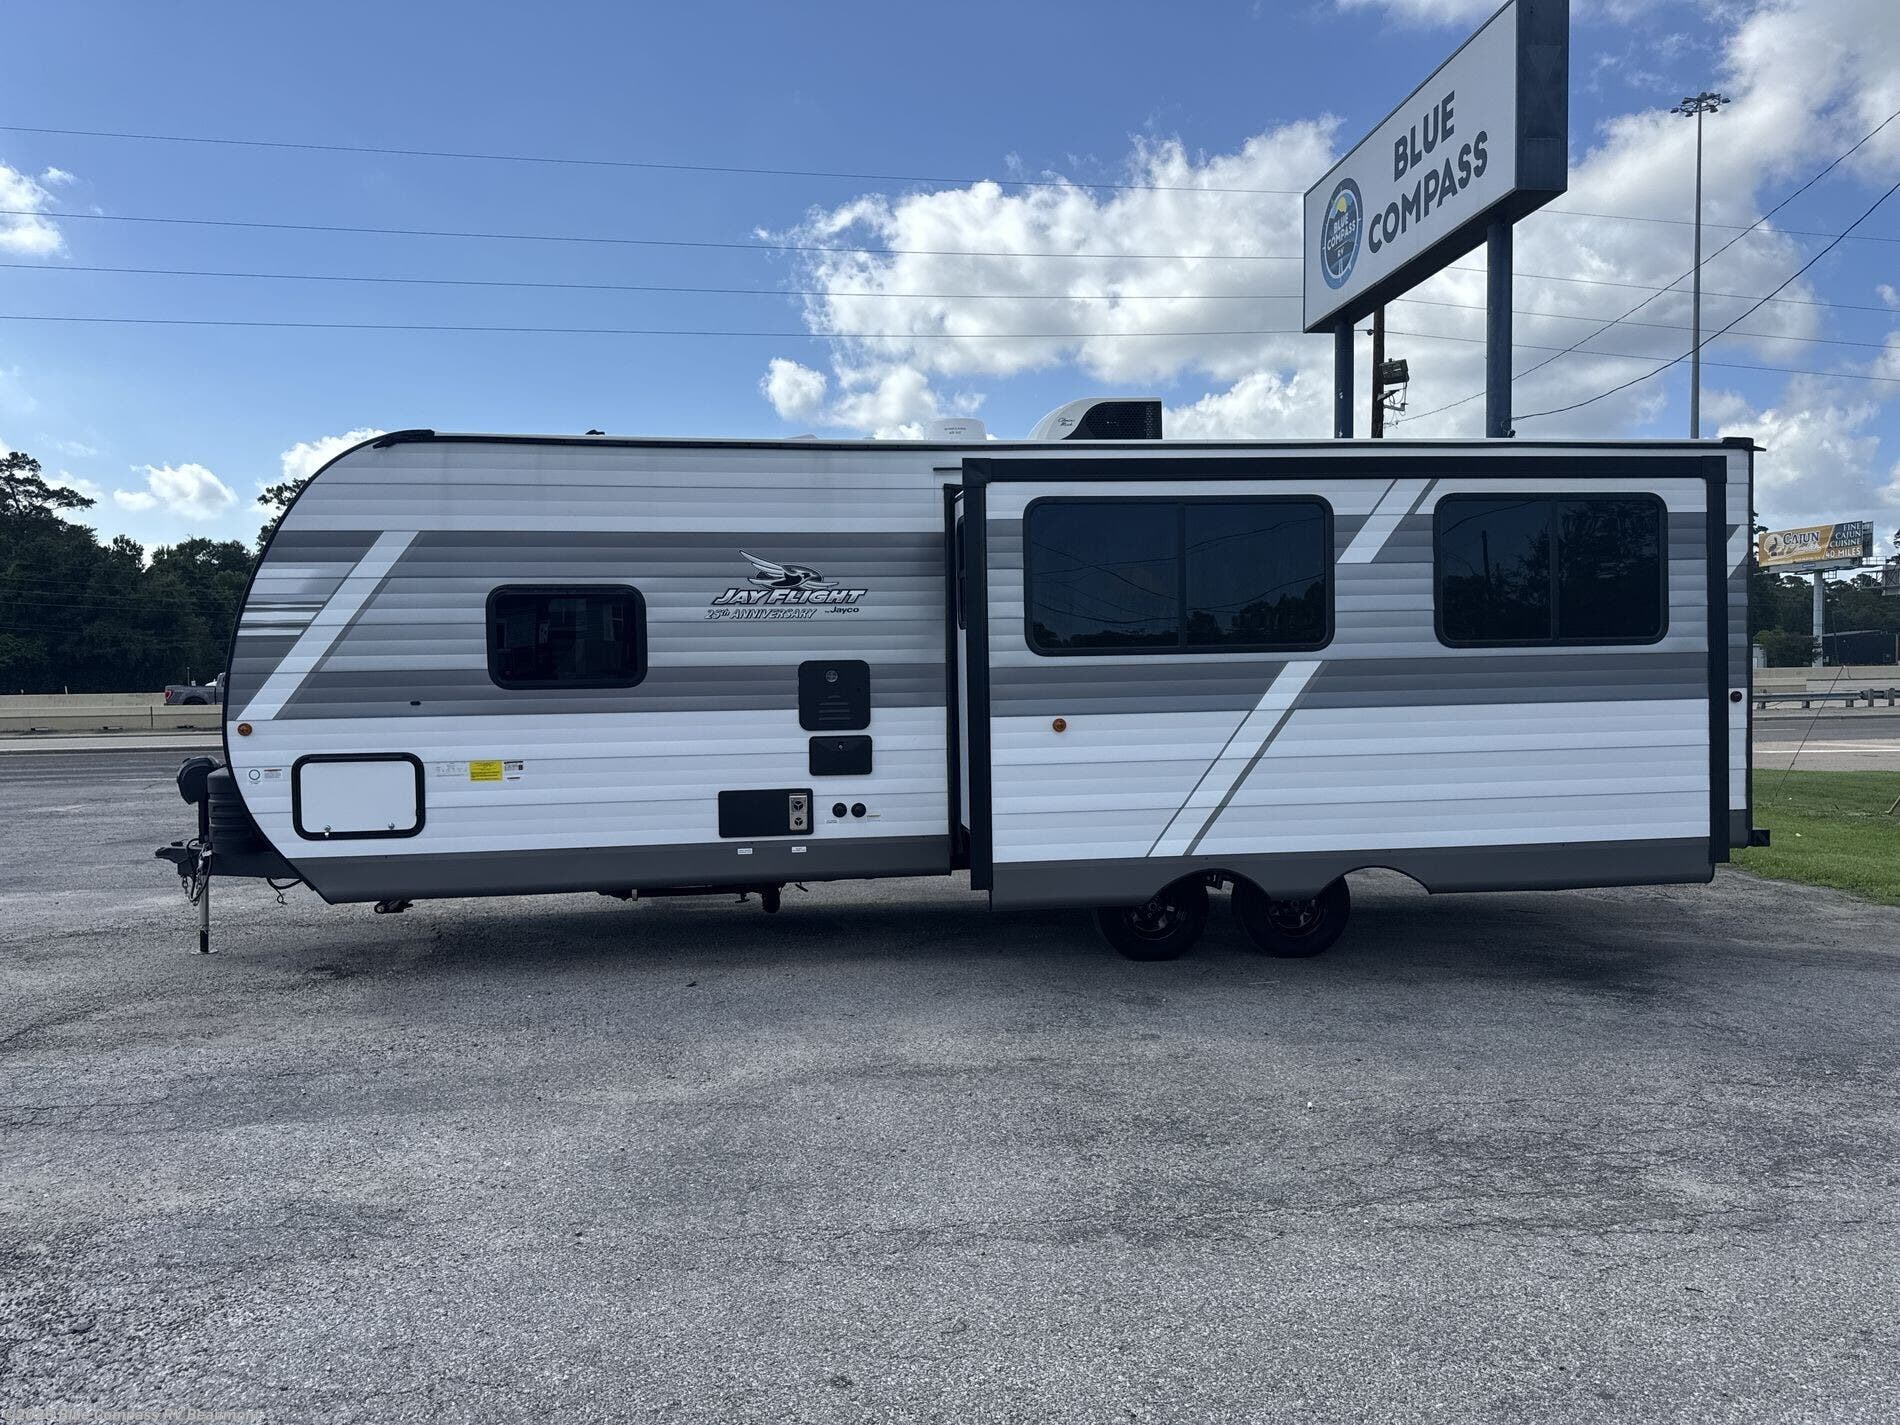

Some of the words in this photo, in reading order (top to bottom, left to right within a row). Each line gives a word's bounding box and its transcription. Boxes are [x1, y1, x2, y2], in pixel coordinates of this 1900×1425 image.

[1394, 90, 1455, 182] BLUE
[1368, 130, 1488, 254] COMPASS
[1333, 212, 1349, 234] BLUE
[1327, 220, 1356, 251] COMPASS
[1843, 522, 1861, 531] FINE
[1783, 531, 1820, 545] CAJUN
[1835, 530, 1861, 540] CAJUN
[1829, 538, 1861, 548] CUISINE
[1825, 550, 1835, 558] 40
[1838, 547, 1861, 558] MILES
[712, 588, 768, 605] JAY
[764, 588, 868, 605] FLIGHT
[705, 608, 730, 620] 25th
[731, 608, 817, 620] ANNIVERSARY
[830, 606, 860, 615] Jayco
